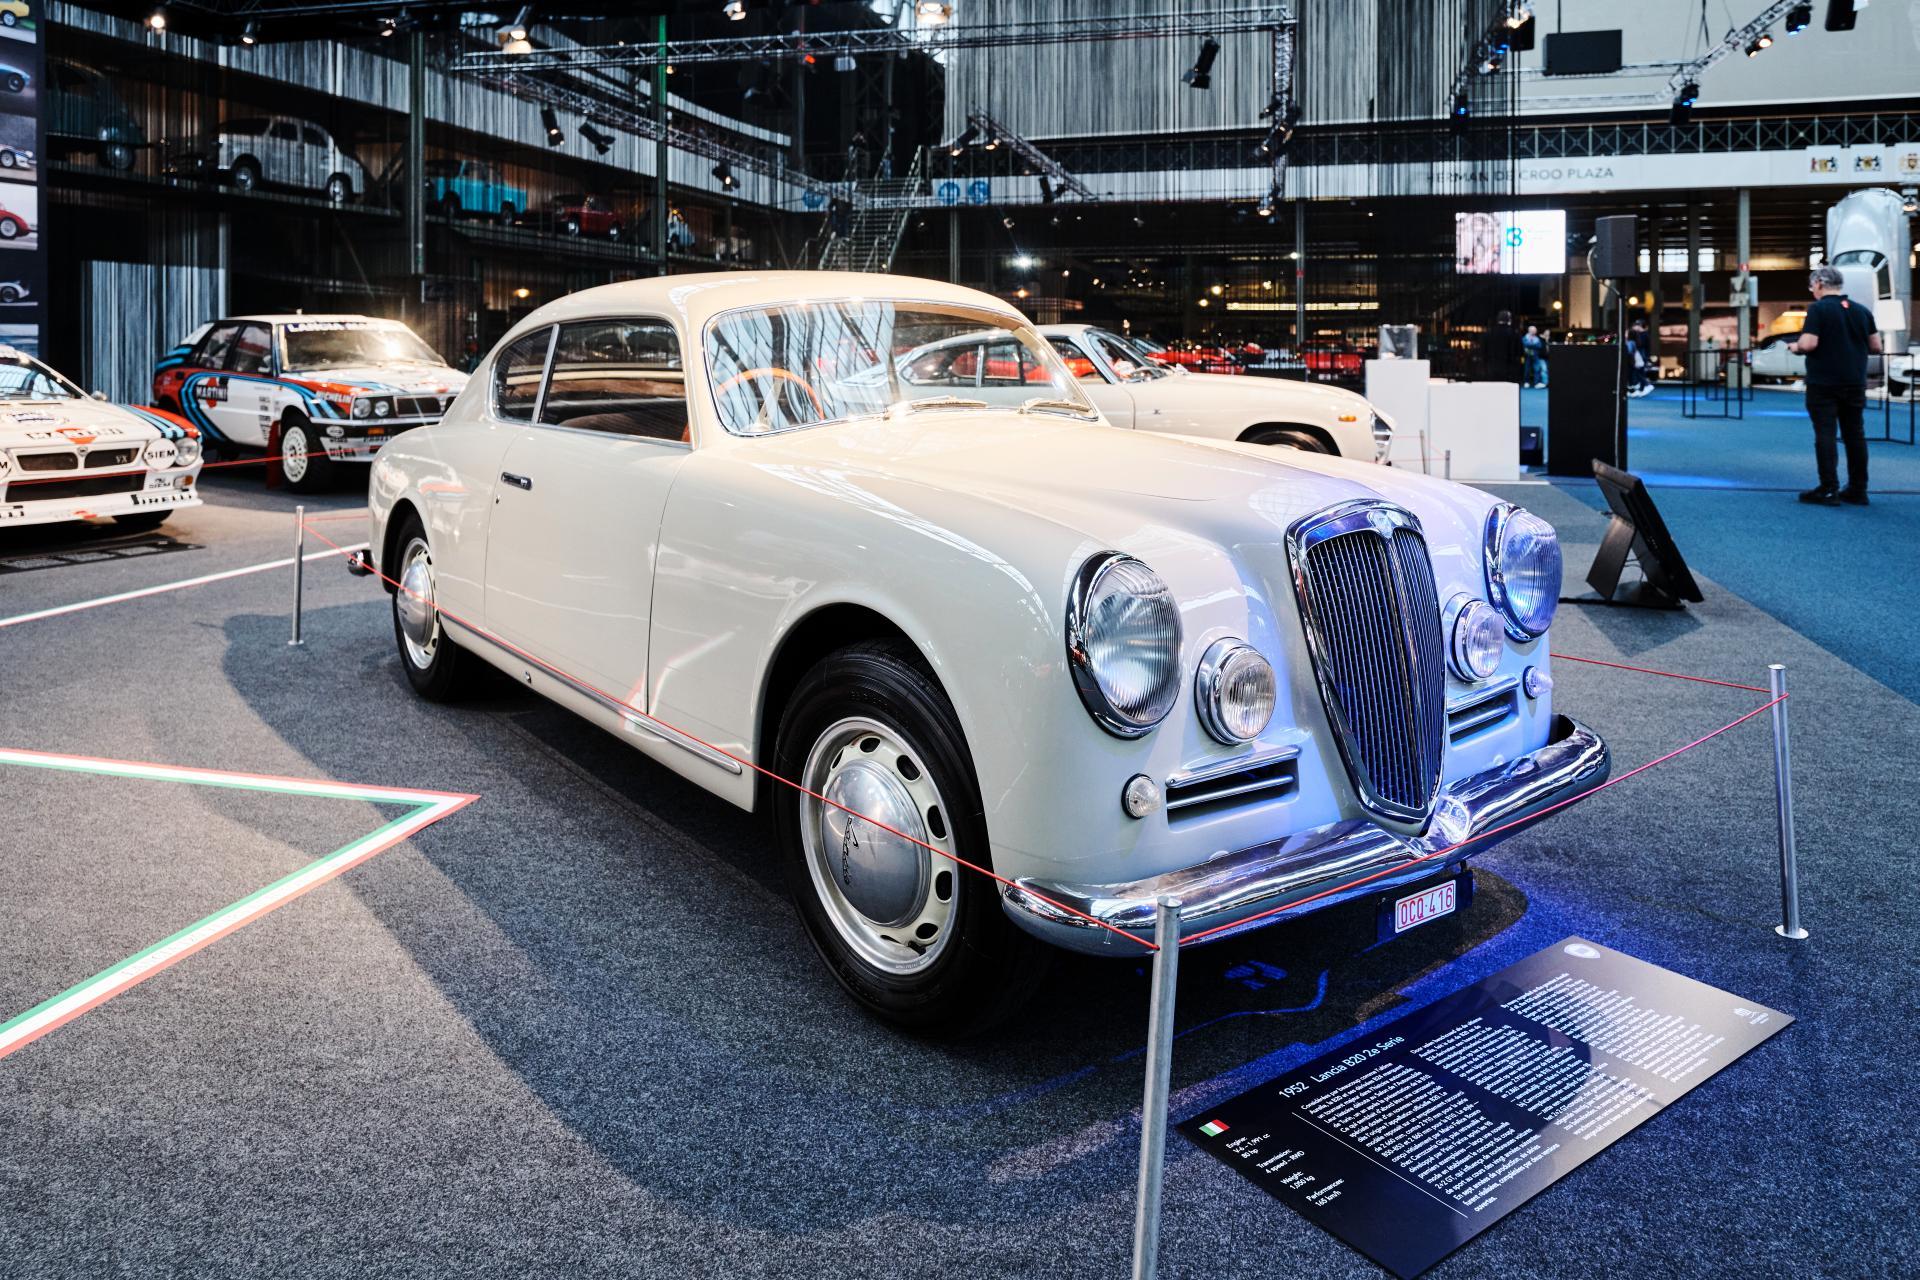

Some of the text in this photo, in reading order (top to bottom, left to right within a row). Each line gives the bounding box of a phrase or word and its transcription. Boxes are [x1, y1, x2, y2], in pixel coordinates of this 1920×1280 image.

[1519, 169, 1562, 180] CROO
[1567, 168, 1614, 179] PLAZA
[195, 386, 227, 401] MARTINI
[147, 449, 176, 459] SIEM
[130, 493, 192, 506] PIRELLI
[1279, 1037, 1405, 1098] 1952 Lancia B20 2e Serie
[1226, 1137, 1247, 1149] Engine:
[1256, 1149, 1292, 1168] Transmission:
[1306, 1179, 1344, 1201] Performances:
